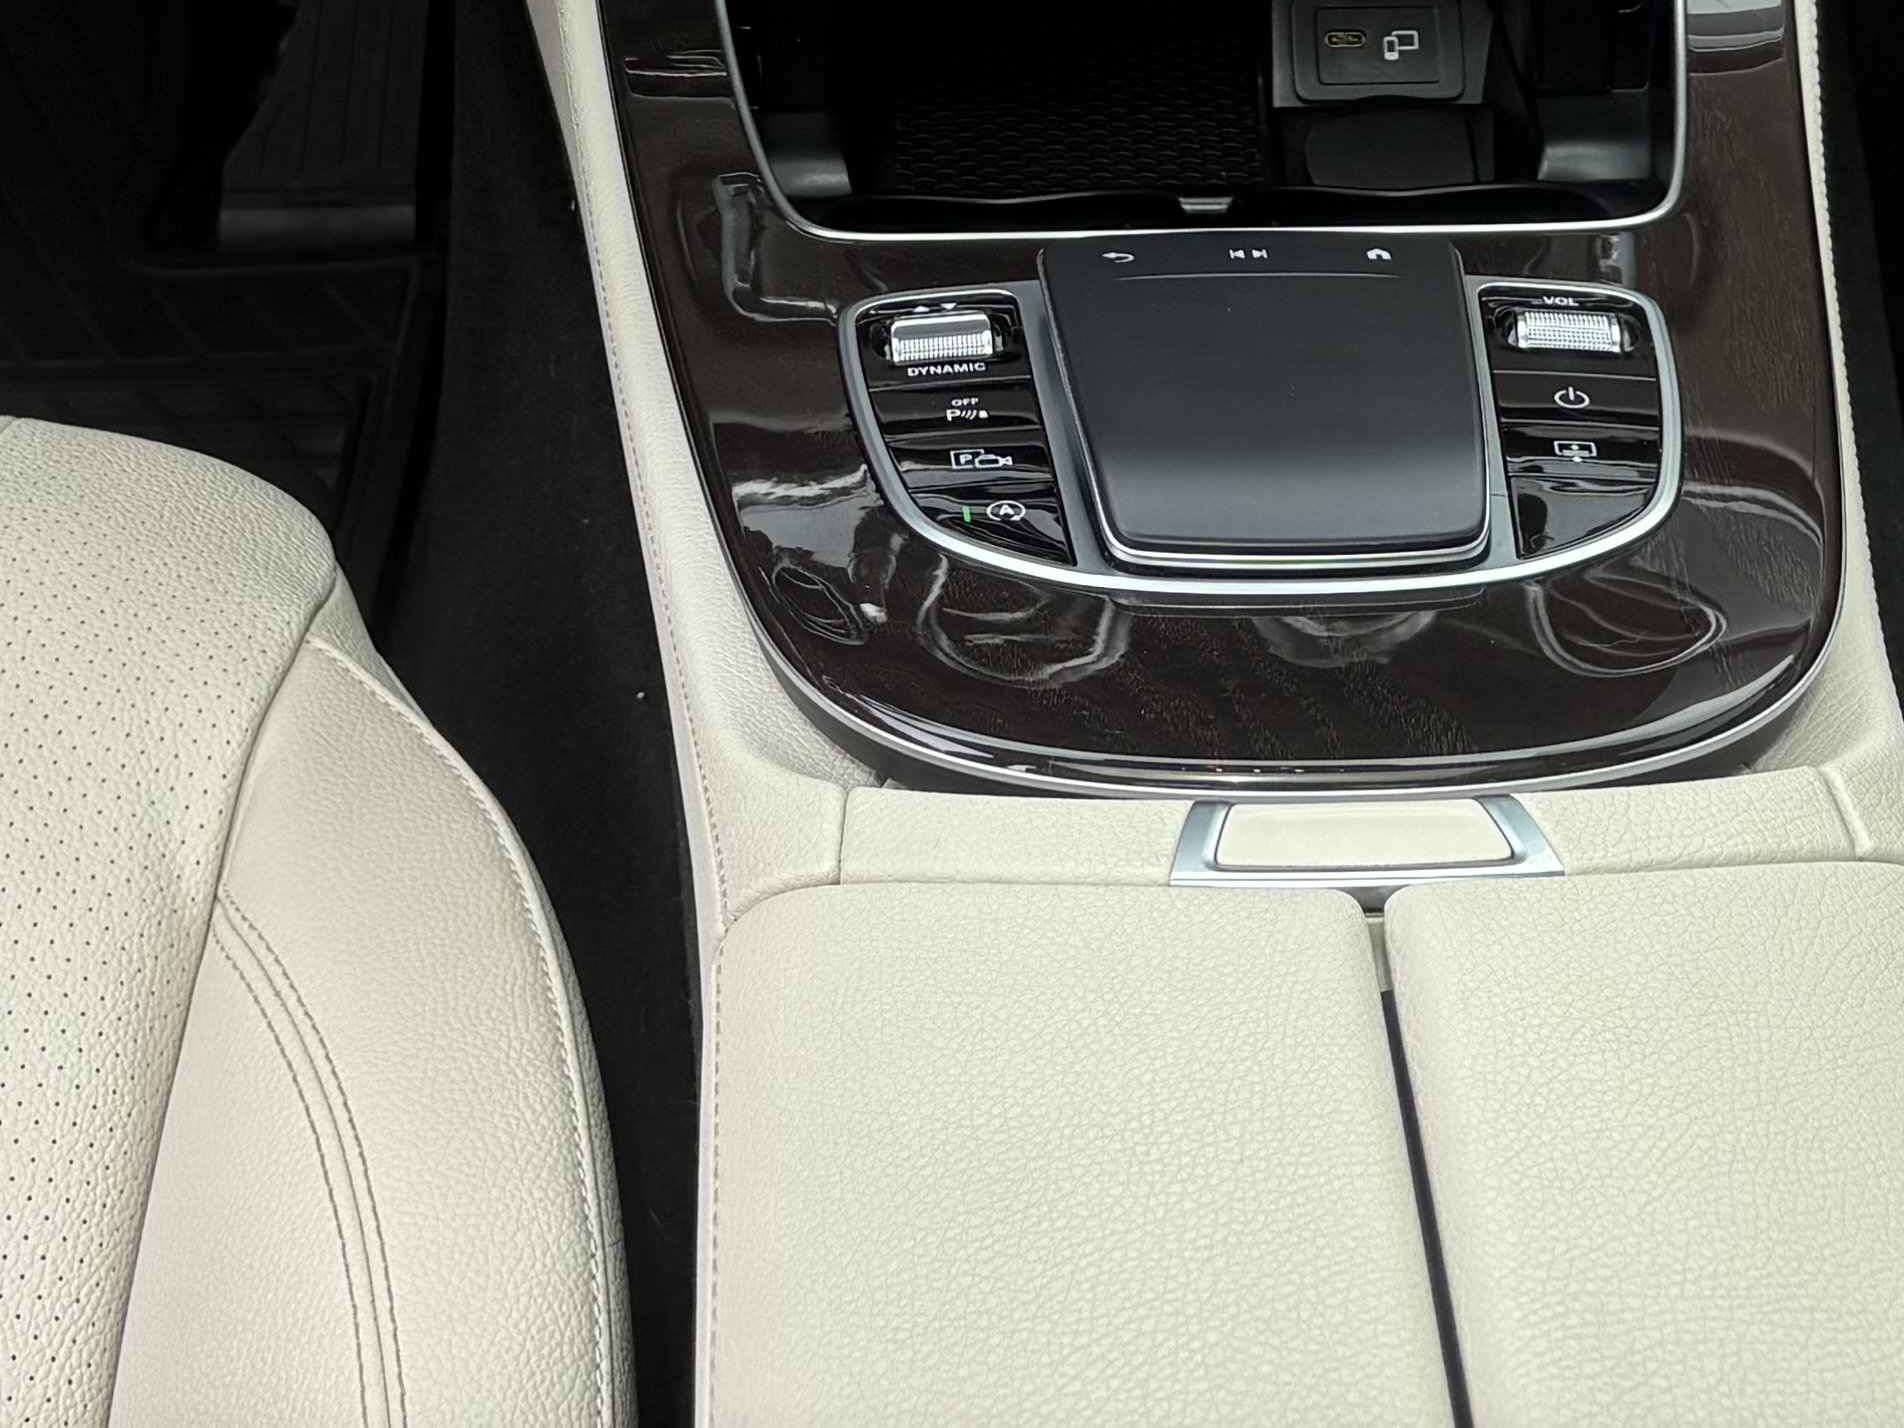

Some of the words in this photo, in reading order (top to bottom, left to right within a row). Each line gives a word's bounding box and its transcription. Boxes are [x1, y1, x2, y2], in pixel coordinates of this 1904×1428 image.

[1542, 295, 1579, 306] VOL
[907, 362, 987, 377] DYNAMIC
[951, 397, 979, 407] OFF
